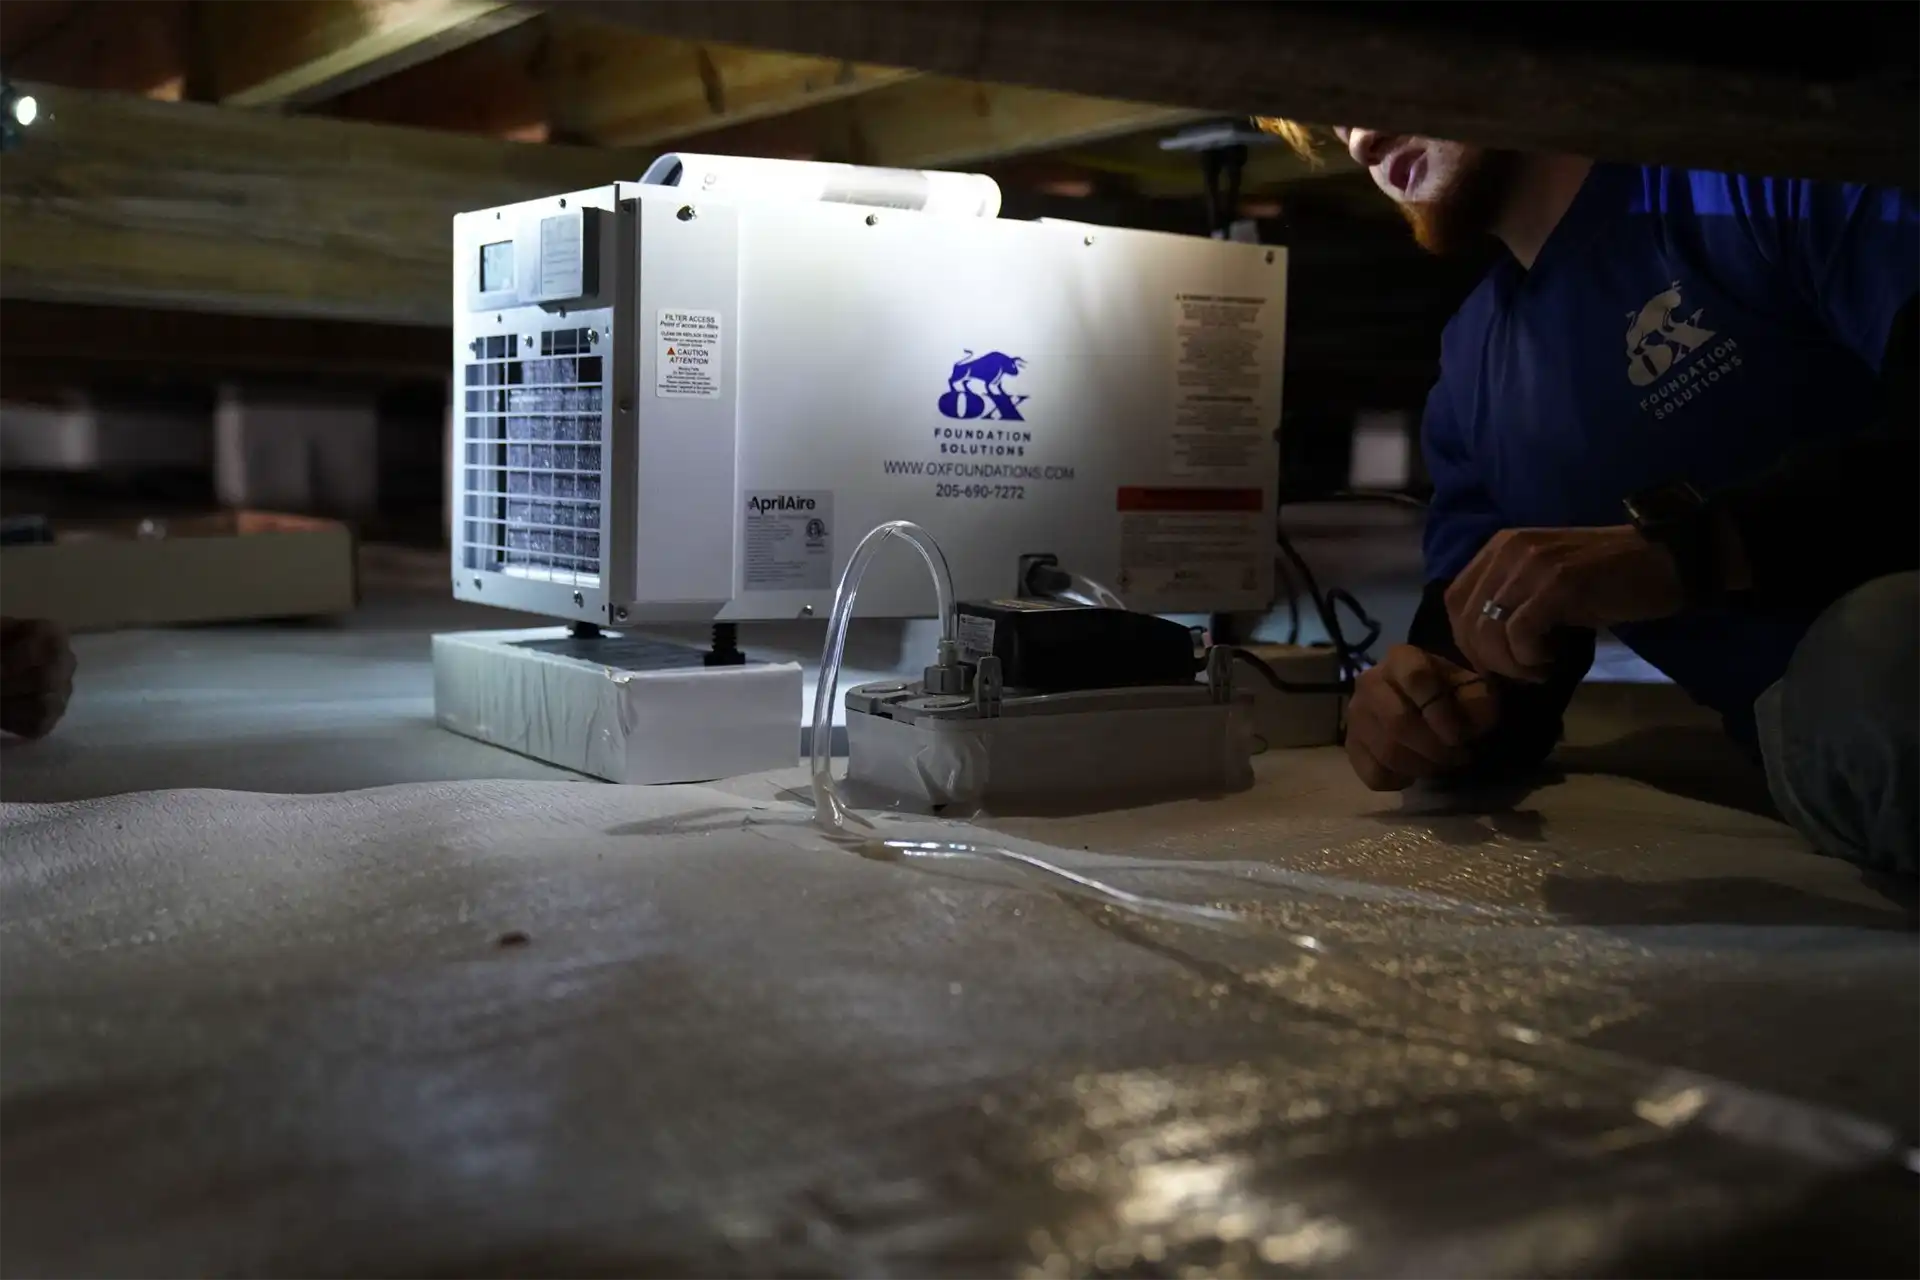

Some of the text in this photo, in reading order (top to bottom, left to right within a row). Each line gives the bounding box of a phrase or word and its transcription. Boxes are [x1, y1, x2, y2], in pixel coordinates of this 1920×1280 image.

[665, 314, 715, 323] FILTER ACCESS
[677, 348, 709, 357] CAUTION
[669, 357, 709, 365] ATTENTION
[1640, 337, 1738, 411] FOUNDATION
[1654, 355, 1743, 420] SOLUTIONS
[938, 390, 1030, 421] OX
[934, 428, 1032, 442] FOUNDATION
[940, 443, 1024, 457] SOLUTIONS
[883, 460, 1075, 480] WWW.OXFOUNDATIONS.COM
[936, 484, 1025, 499] 205-690-7272
[748, 495, 816, 515] AprilAire
